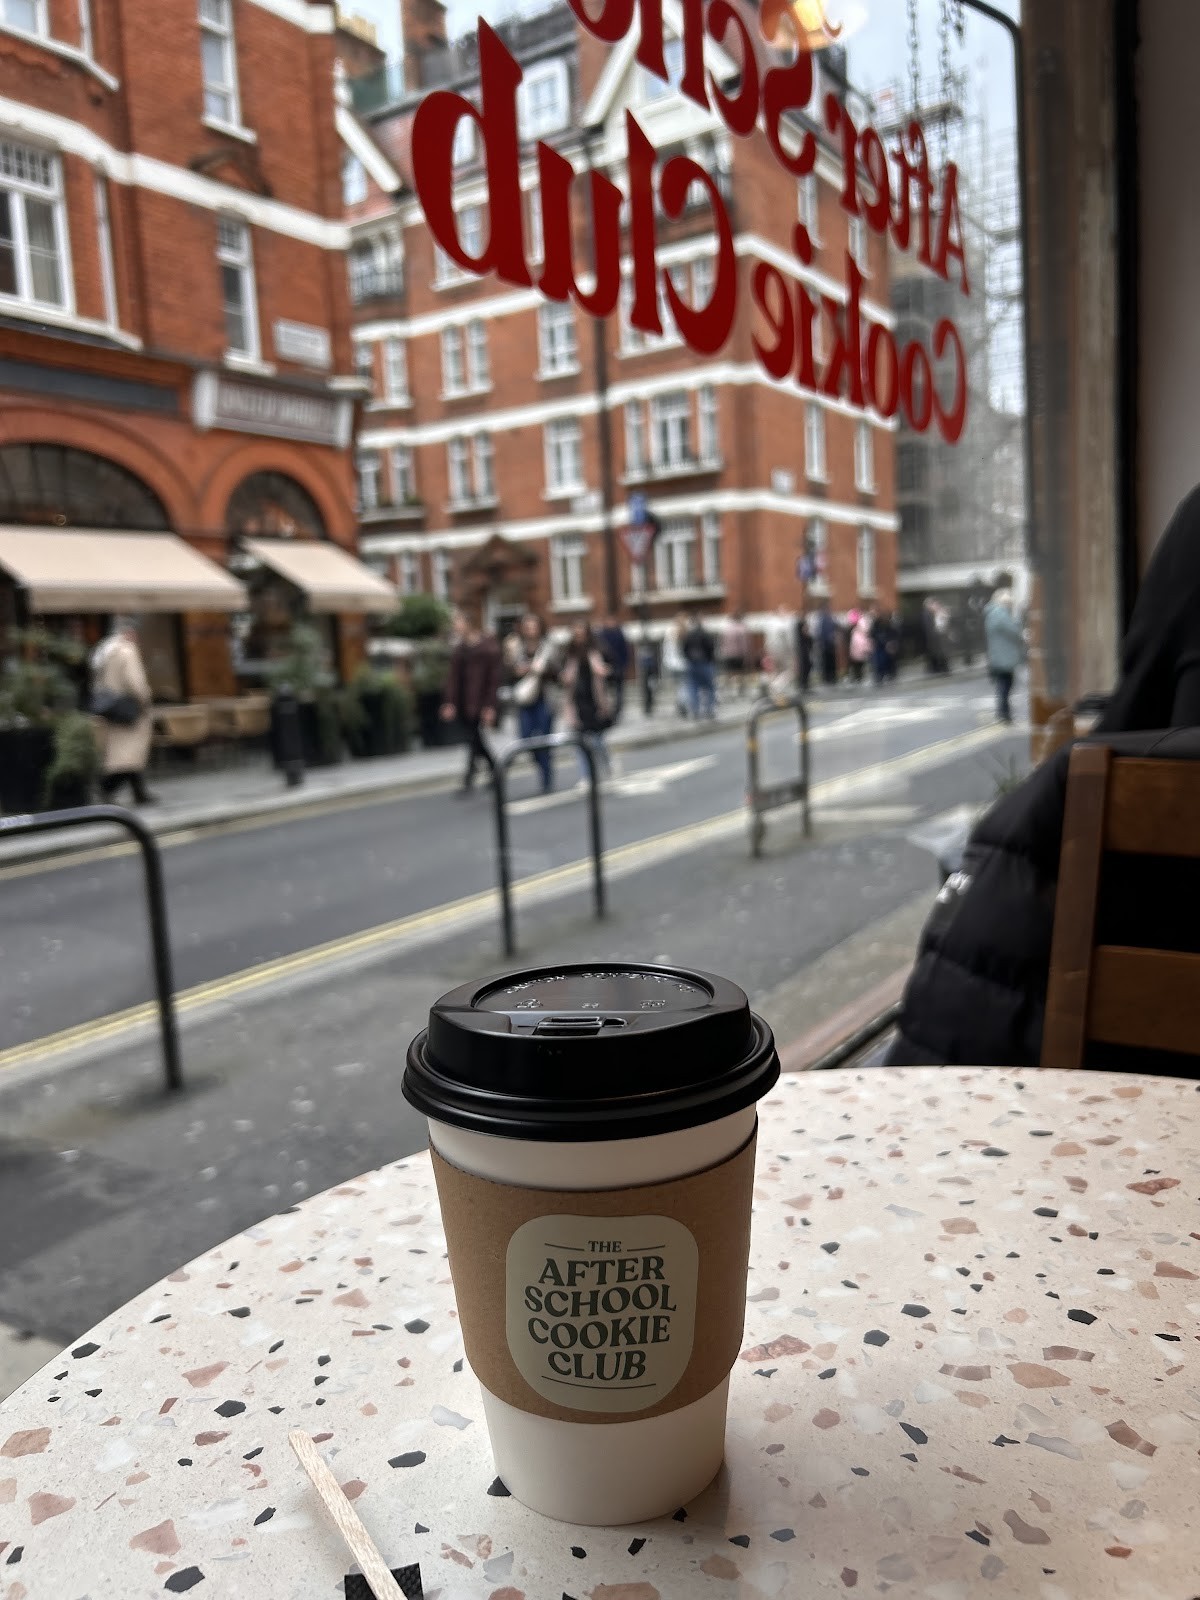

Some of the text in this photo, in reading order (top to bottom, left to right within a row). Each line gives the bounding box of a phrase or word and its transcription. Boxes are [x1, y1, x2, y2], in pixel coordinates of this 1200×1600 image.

[588, 1240, 622, 1253] THE
[538, 1255, 666, 1287] AFTER
[524, 1283, 678, 1318] SCHOOL
[527, 1315, 671, 1349] COOKIE
[547, 1350, 647, 1381] CLUB
